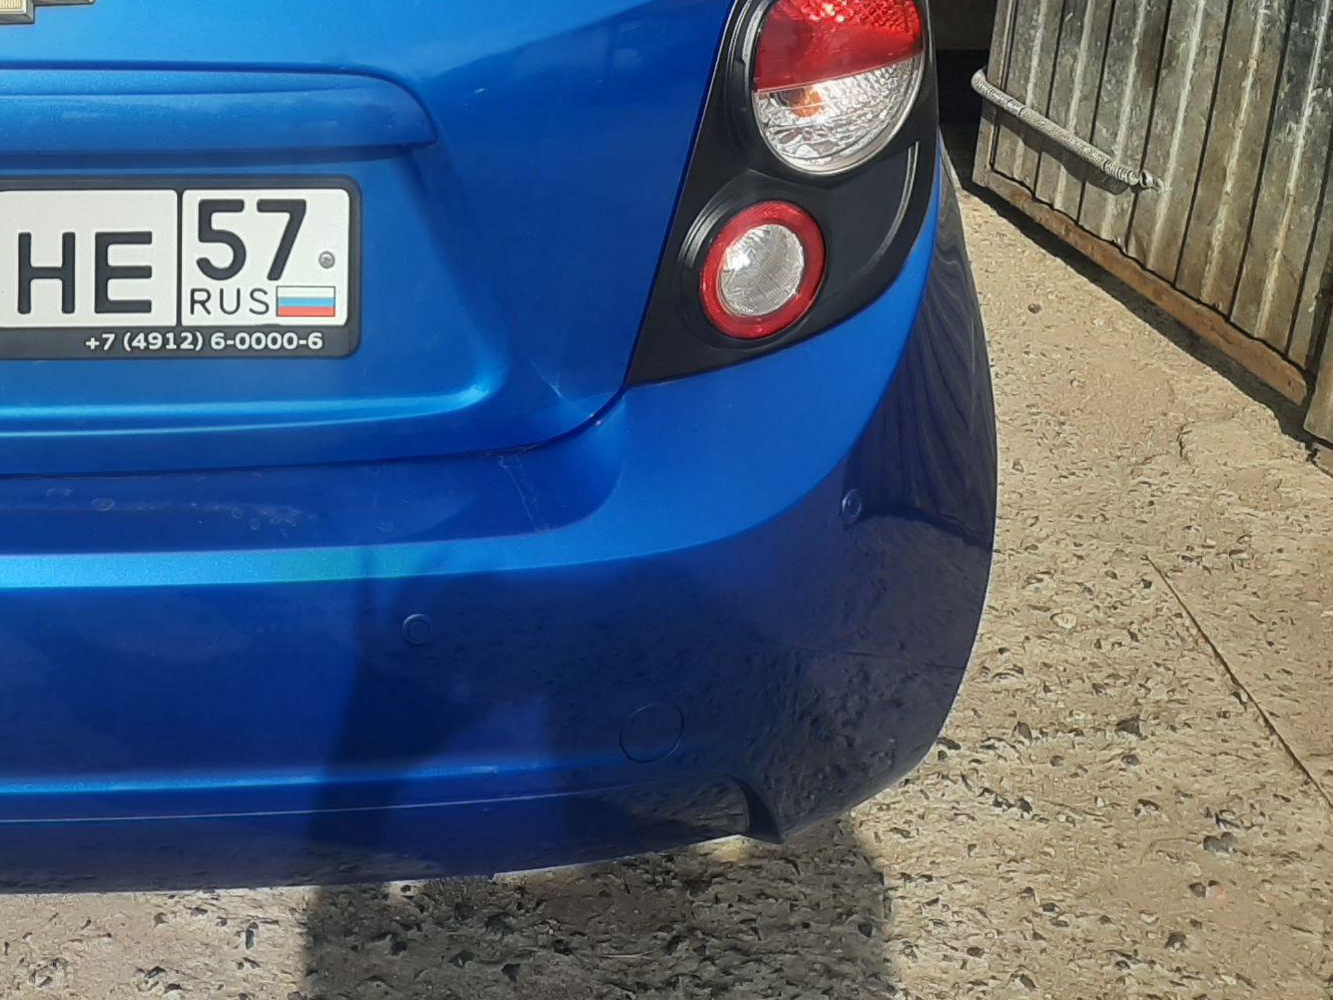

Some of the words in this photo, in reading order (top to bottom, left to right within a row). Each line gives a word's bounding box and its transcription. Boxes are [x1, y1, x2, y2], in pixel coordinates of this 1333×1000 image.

[197, 199, 307, 282] 57
[190, 286, 269, 316] RUS
[85, 334, 116, 351] +7
[123, 331, 203, 351] (4912)
[210, 332, 323, 350] 6-0000-6
